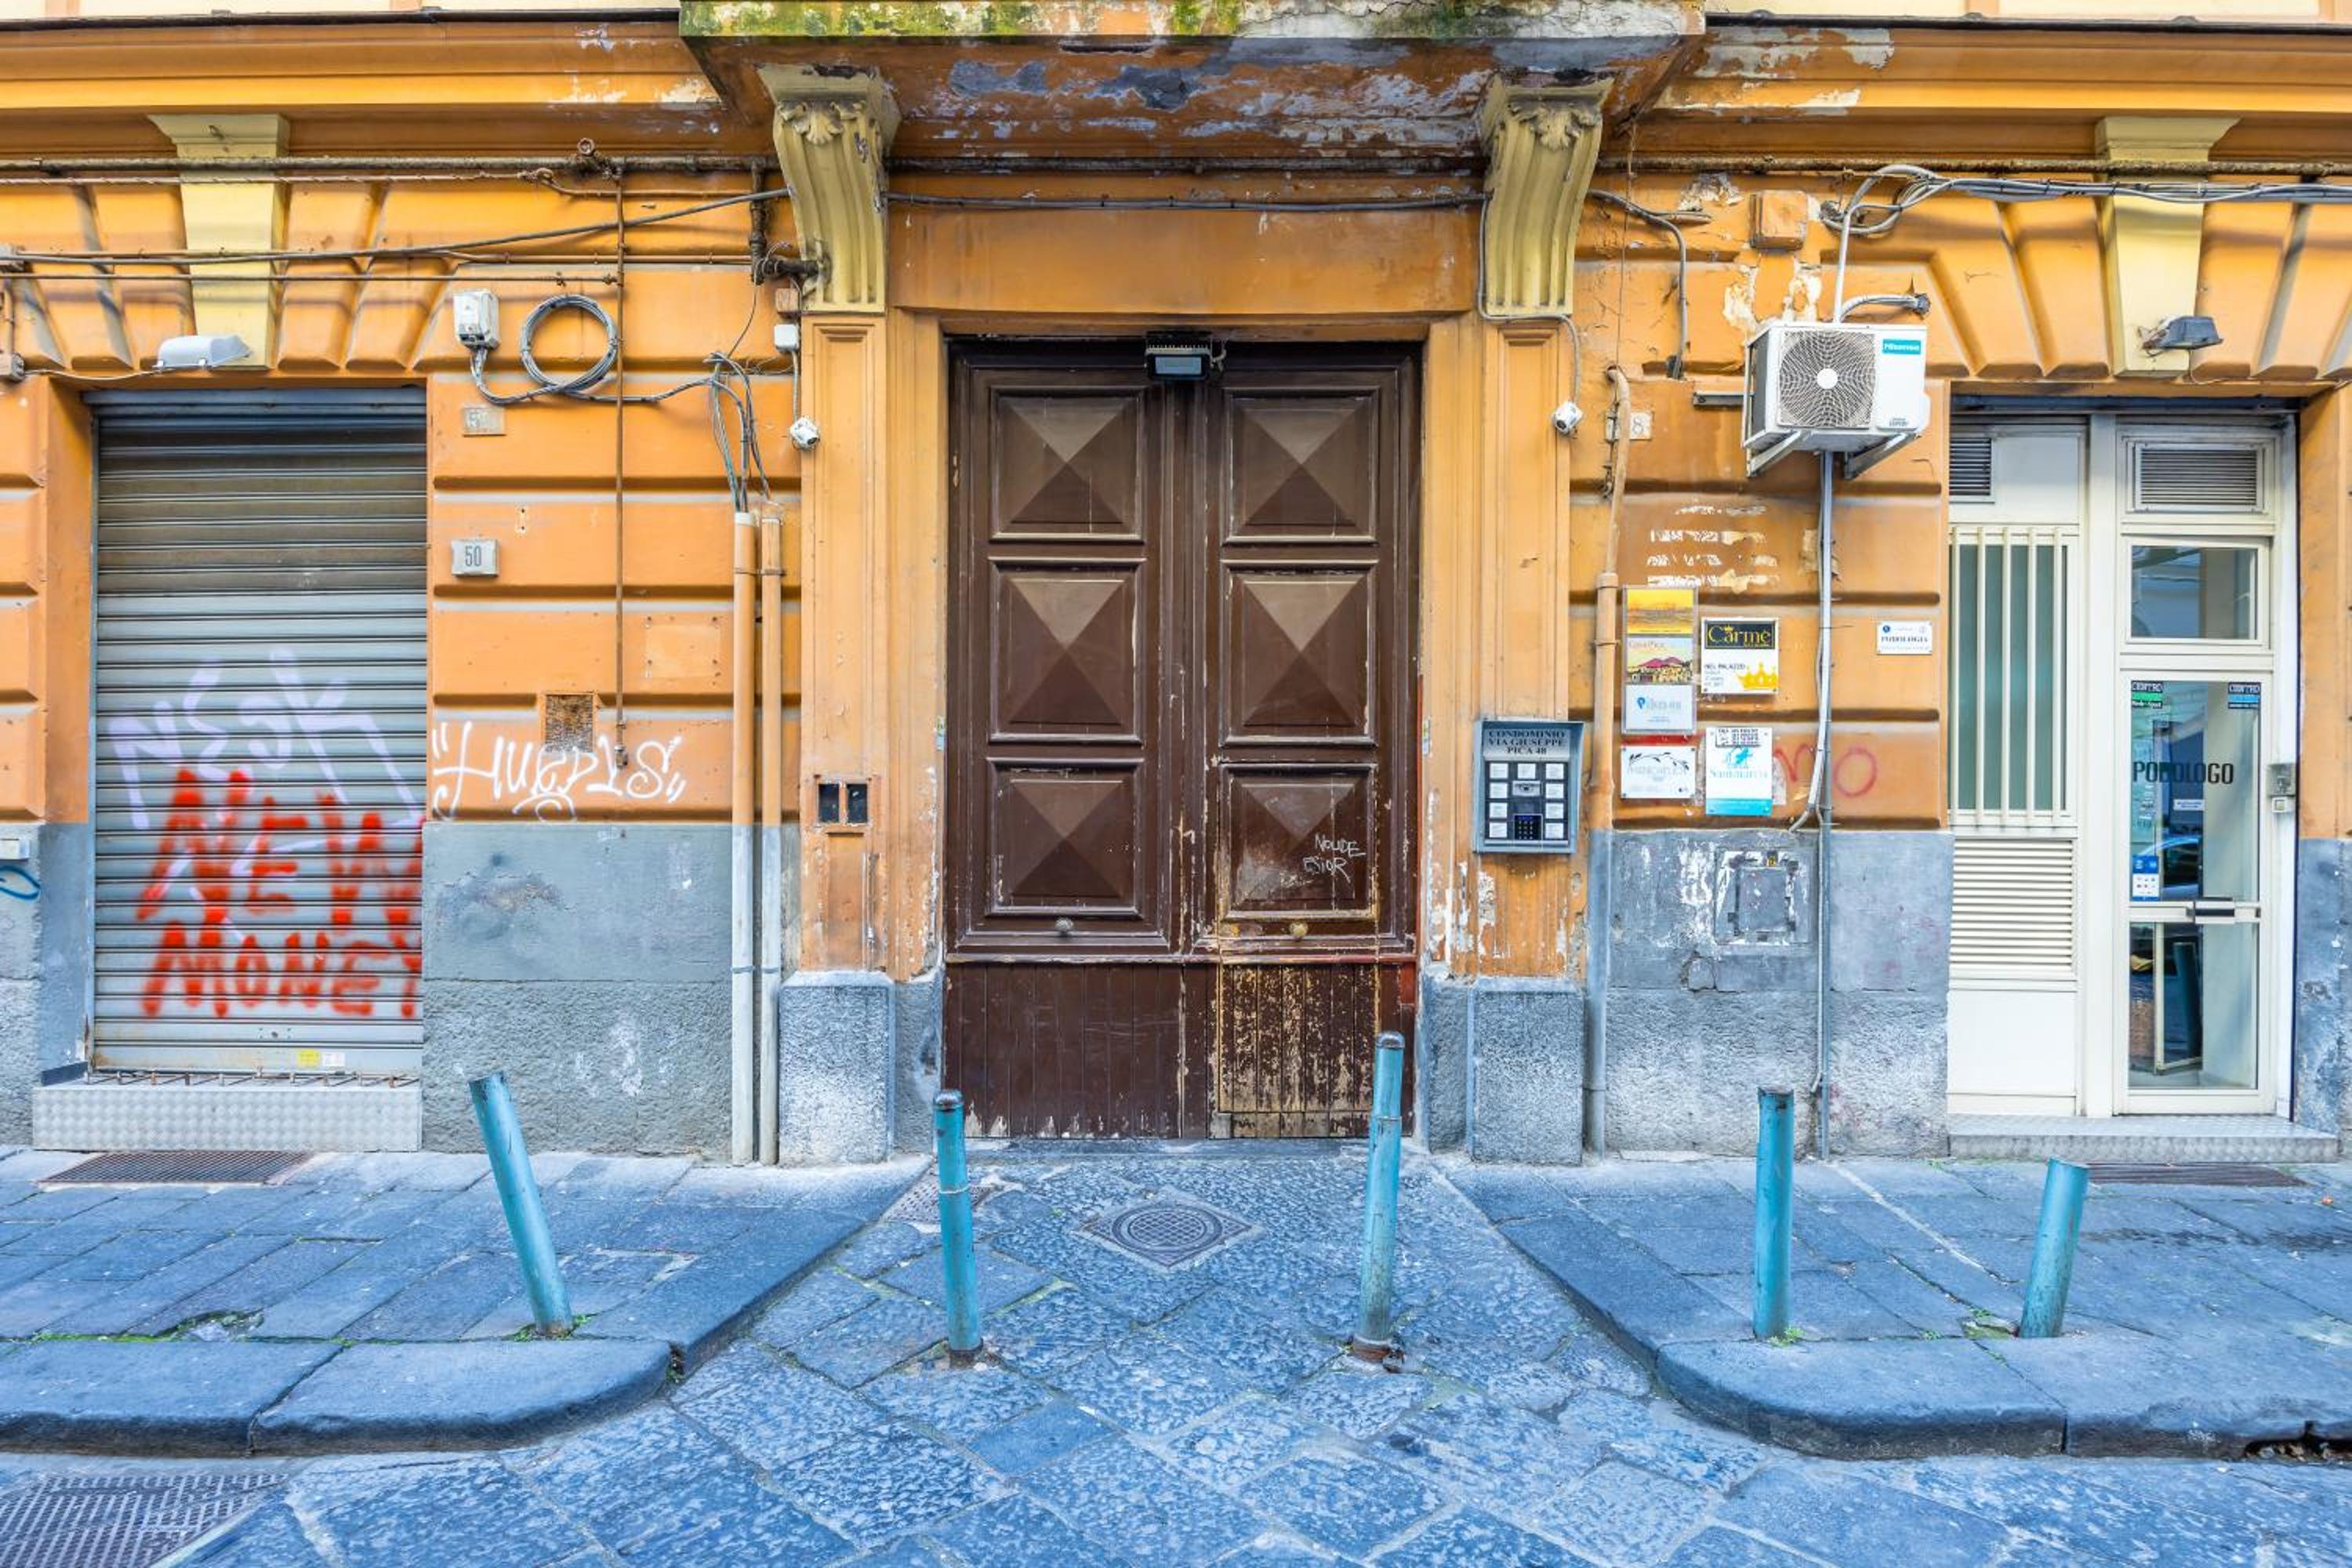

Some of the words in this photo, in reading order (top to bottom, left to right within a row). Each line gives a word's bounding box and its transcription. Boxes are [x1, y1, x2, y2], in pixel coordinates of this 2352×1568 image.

[464, 545, 482, 567] 50
[2132, 761, 2234, 784] PODOLOGO
[136, 768, 423, 941] NEW
[140, 920, 423, 1019] MONEY
